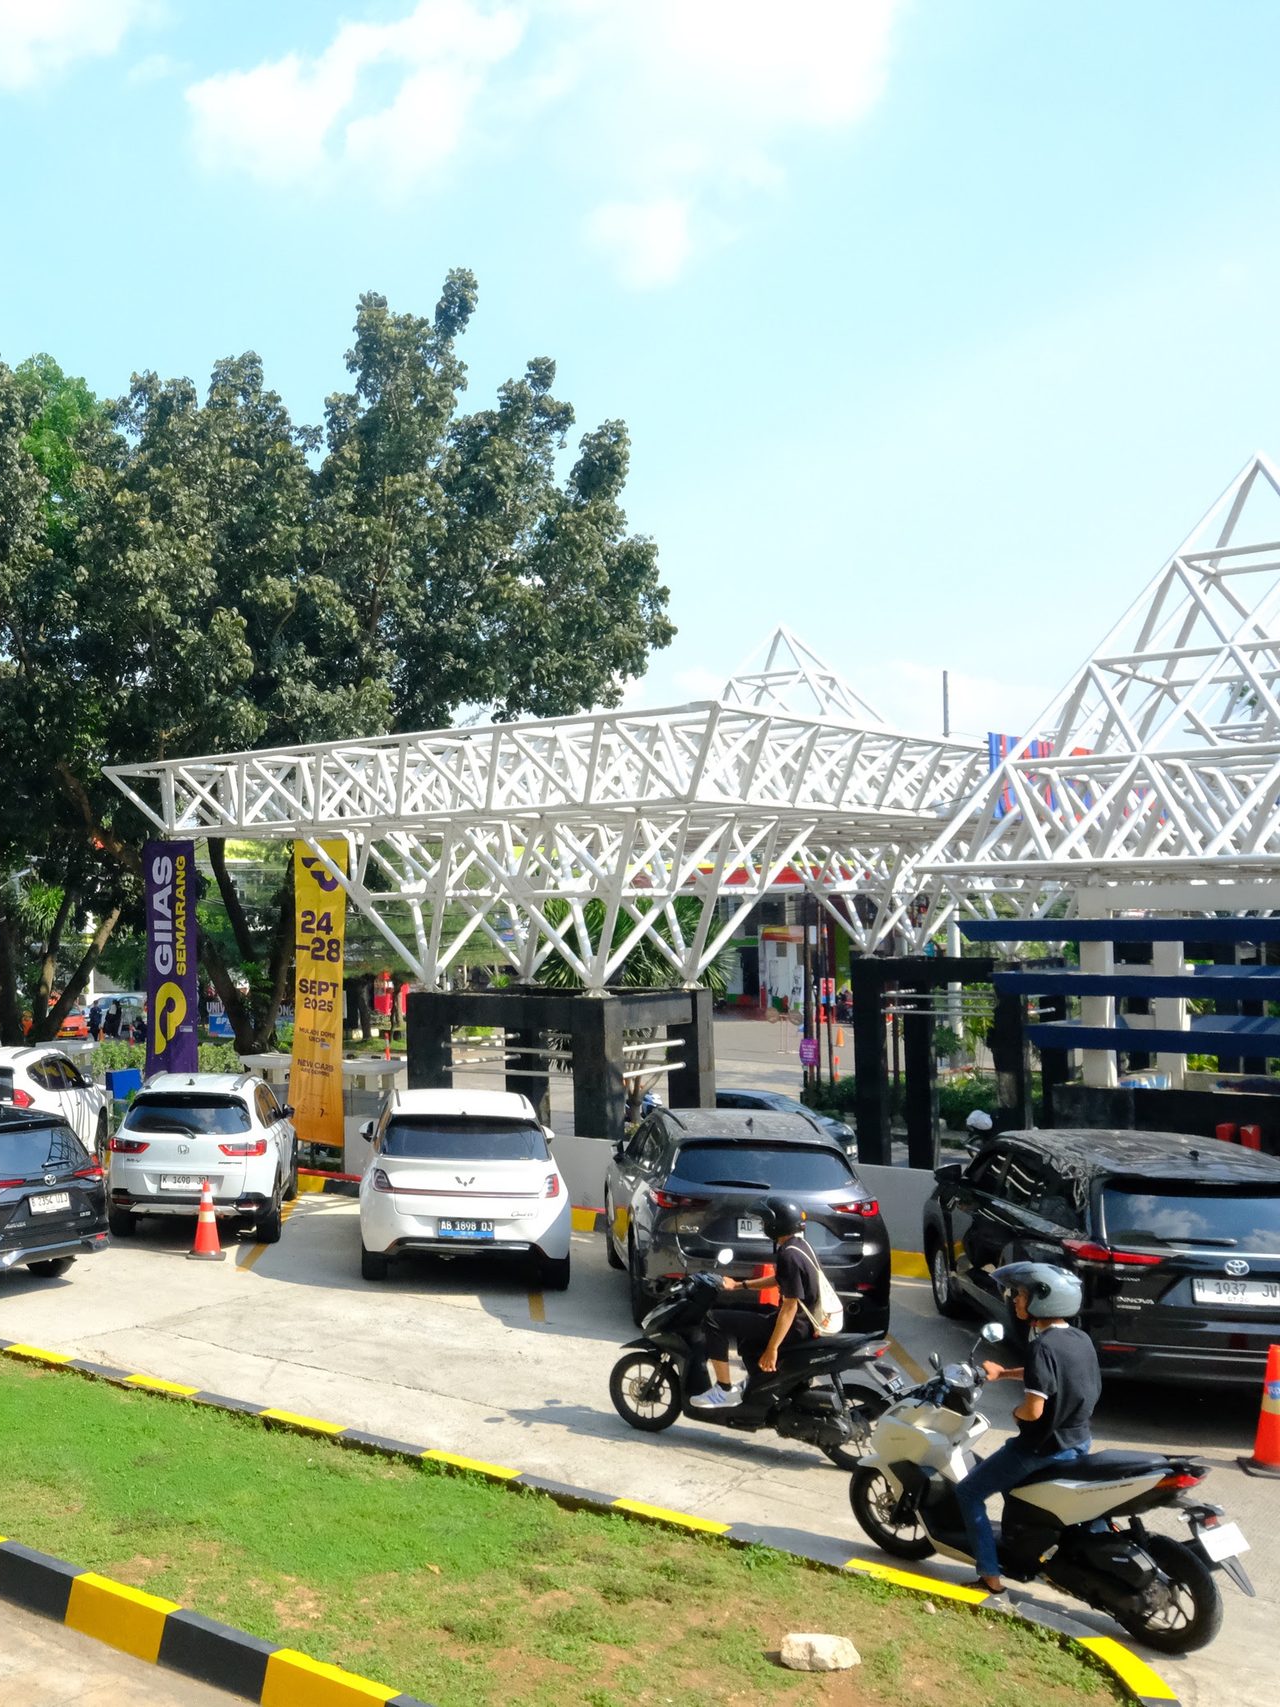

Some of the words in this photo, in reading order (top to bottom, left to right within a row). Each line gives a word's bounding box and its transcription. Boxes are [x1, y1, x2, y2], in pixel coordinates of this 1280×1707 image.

[152, 856, 173, 975] GIIAS
[175, 855, 187, 976] SEMARANG
[301, 910, 334, 935] 24
[299, 979, 339, 998] SEPT
[304, 997, 334, 1012] 2025
[297, 1059, 313, 1068] NEW
[314, 1062, 334, 1072] CARS
[162, 1175, 167, 1183] K
[441, 1221, 452, 1230] AB
[455, 1221, 477, 1231] 1898
[740, 1219, 753, 1231] AD
[1196, 1280, 1205, 1293] H
[1215, 1282, 1247, 1296] 1937
[1262, 1284, 1277, 1298] JV
